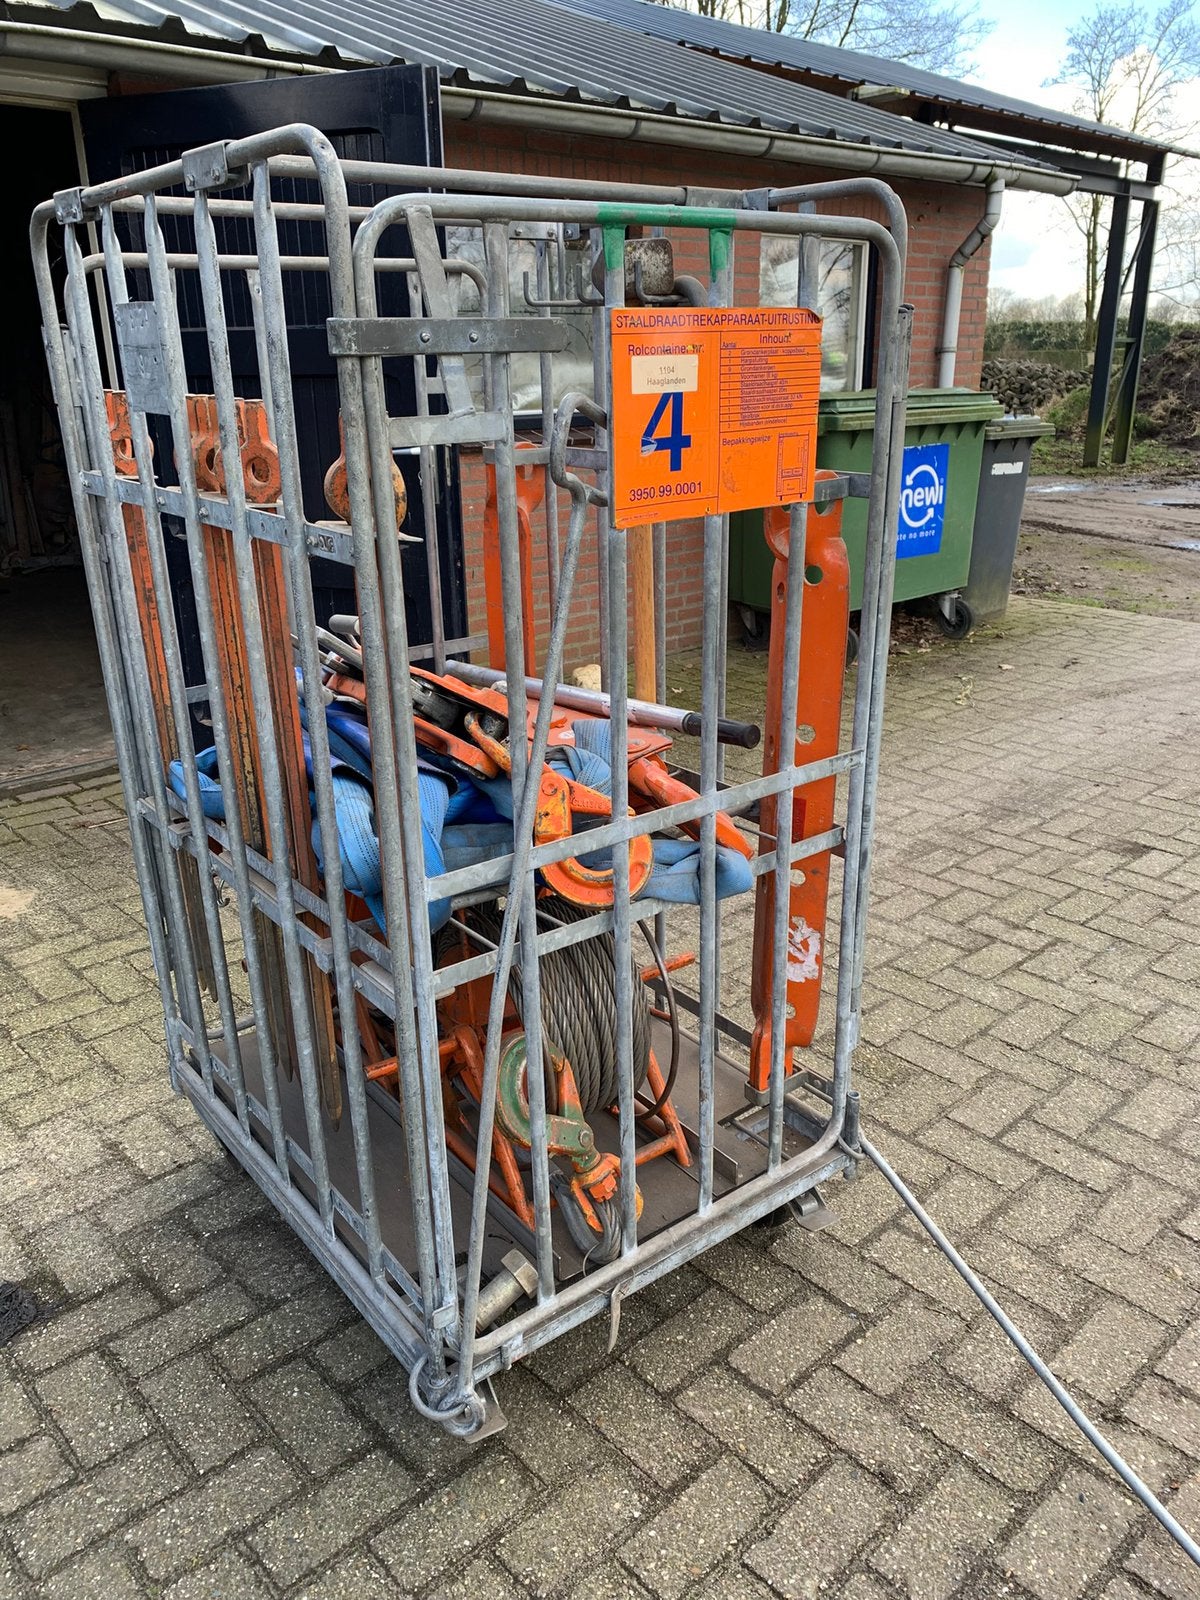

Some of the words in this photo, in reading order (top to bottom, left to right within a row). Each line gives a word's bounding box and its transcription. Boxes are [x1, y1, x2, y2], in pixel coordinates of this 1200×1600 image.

[616, 313, 821, 328] STAALDRAADTREKAPPARAAT-UITRUSTING
[659, 365, 675, 375] 1104
[647, 377, 687, 387] Haaglanden
[641, 391, 691, 472] 4
[629, 481, 702, 502] 3950.99.0001
[899, 477, 944, 509] newi
[919, 530, 936, 538] more
